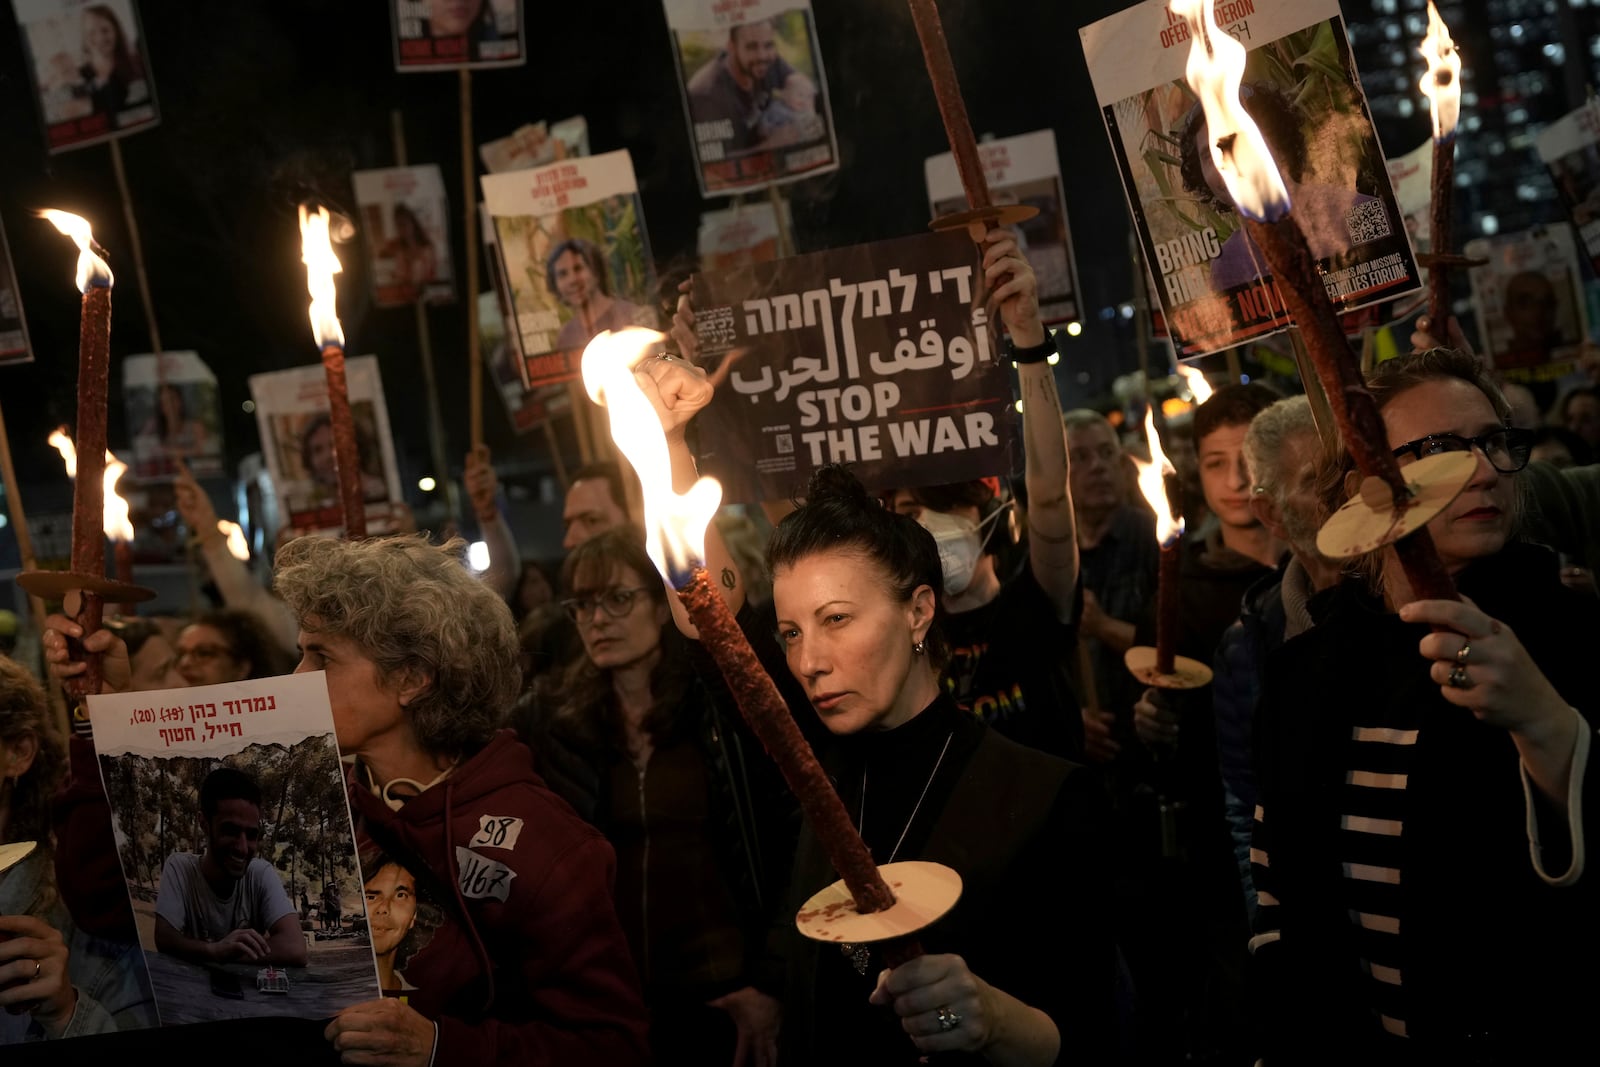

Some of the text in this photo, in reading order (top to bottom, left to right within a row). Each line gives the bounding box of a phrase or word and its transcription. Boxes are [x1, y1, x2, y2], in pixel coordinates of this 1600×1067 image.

[1159, 22, 1190, 49] OFER
[1154, 227, 1222, 275] BRING
[1356, 262, 1371, 276] AND
[1370, 252, 1402, 272] MISSING
[1325, 263, 1408, 298] FAMILIES FORUM
[742, 266, 973, 337] די למלחמה
[731, 308, 991, 404] أوقف الحرب
[797, 382, 901, 427] STOP
[801, 425, 883, 467] THE
[888, 412, 999, 457] WAR
[129, 708, 156, 726] (20),
[189, 705, 217, 726] כהן
[223, 694, 276, 716] נמרוד
[159, 721, 243, 747] חייל, חטוף
[476, 818, 516, 846] 98
